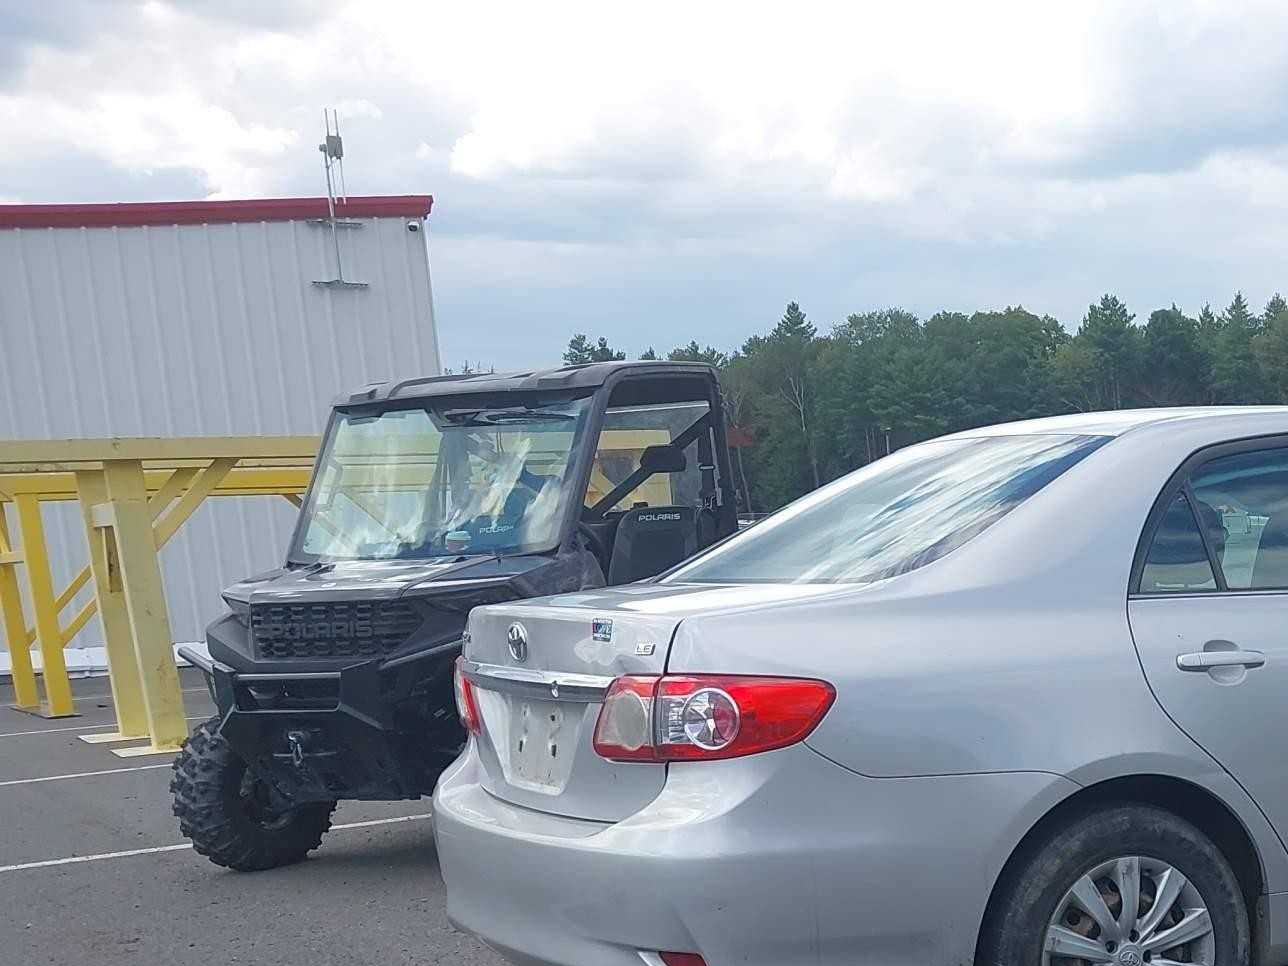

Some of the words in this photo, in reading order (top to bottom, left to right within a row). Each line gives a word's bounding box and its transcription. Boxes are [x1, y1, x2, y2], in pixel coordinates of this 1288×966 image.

[638, 513, 681, 521] POLARIS
[479, 525, 514, 533] POLAR
[269, 622, 373, 639] POLARIS
[636, 643, 653, 654] LE
